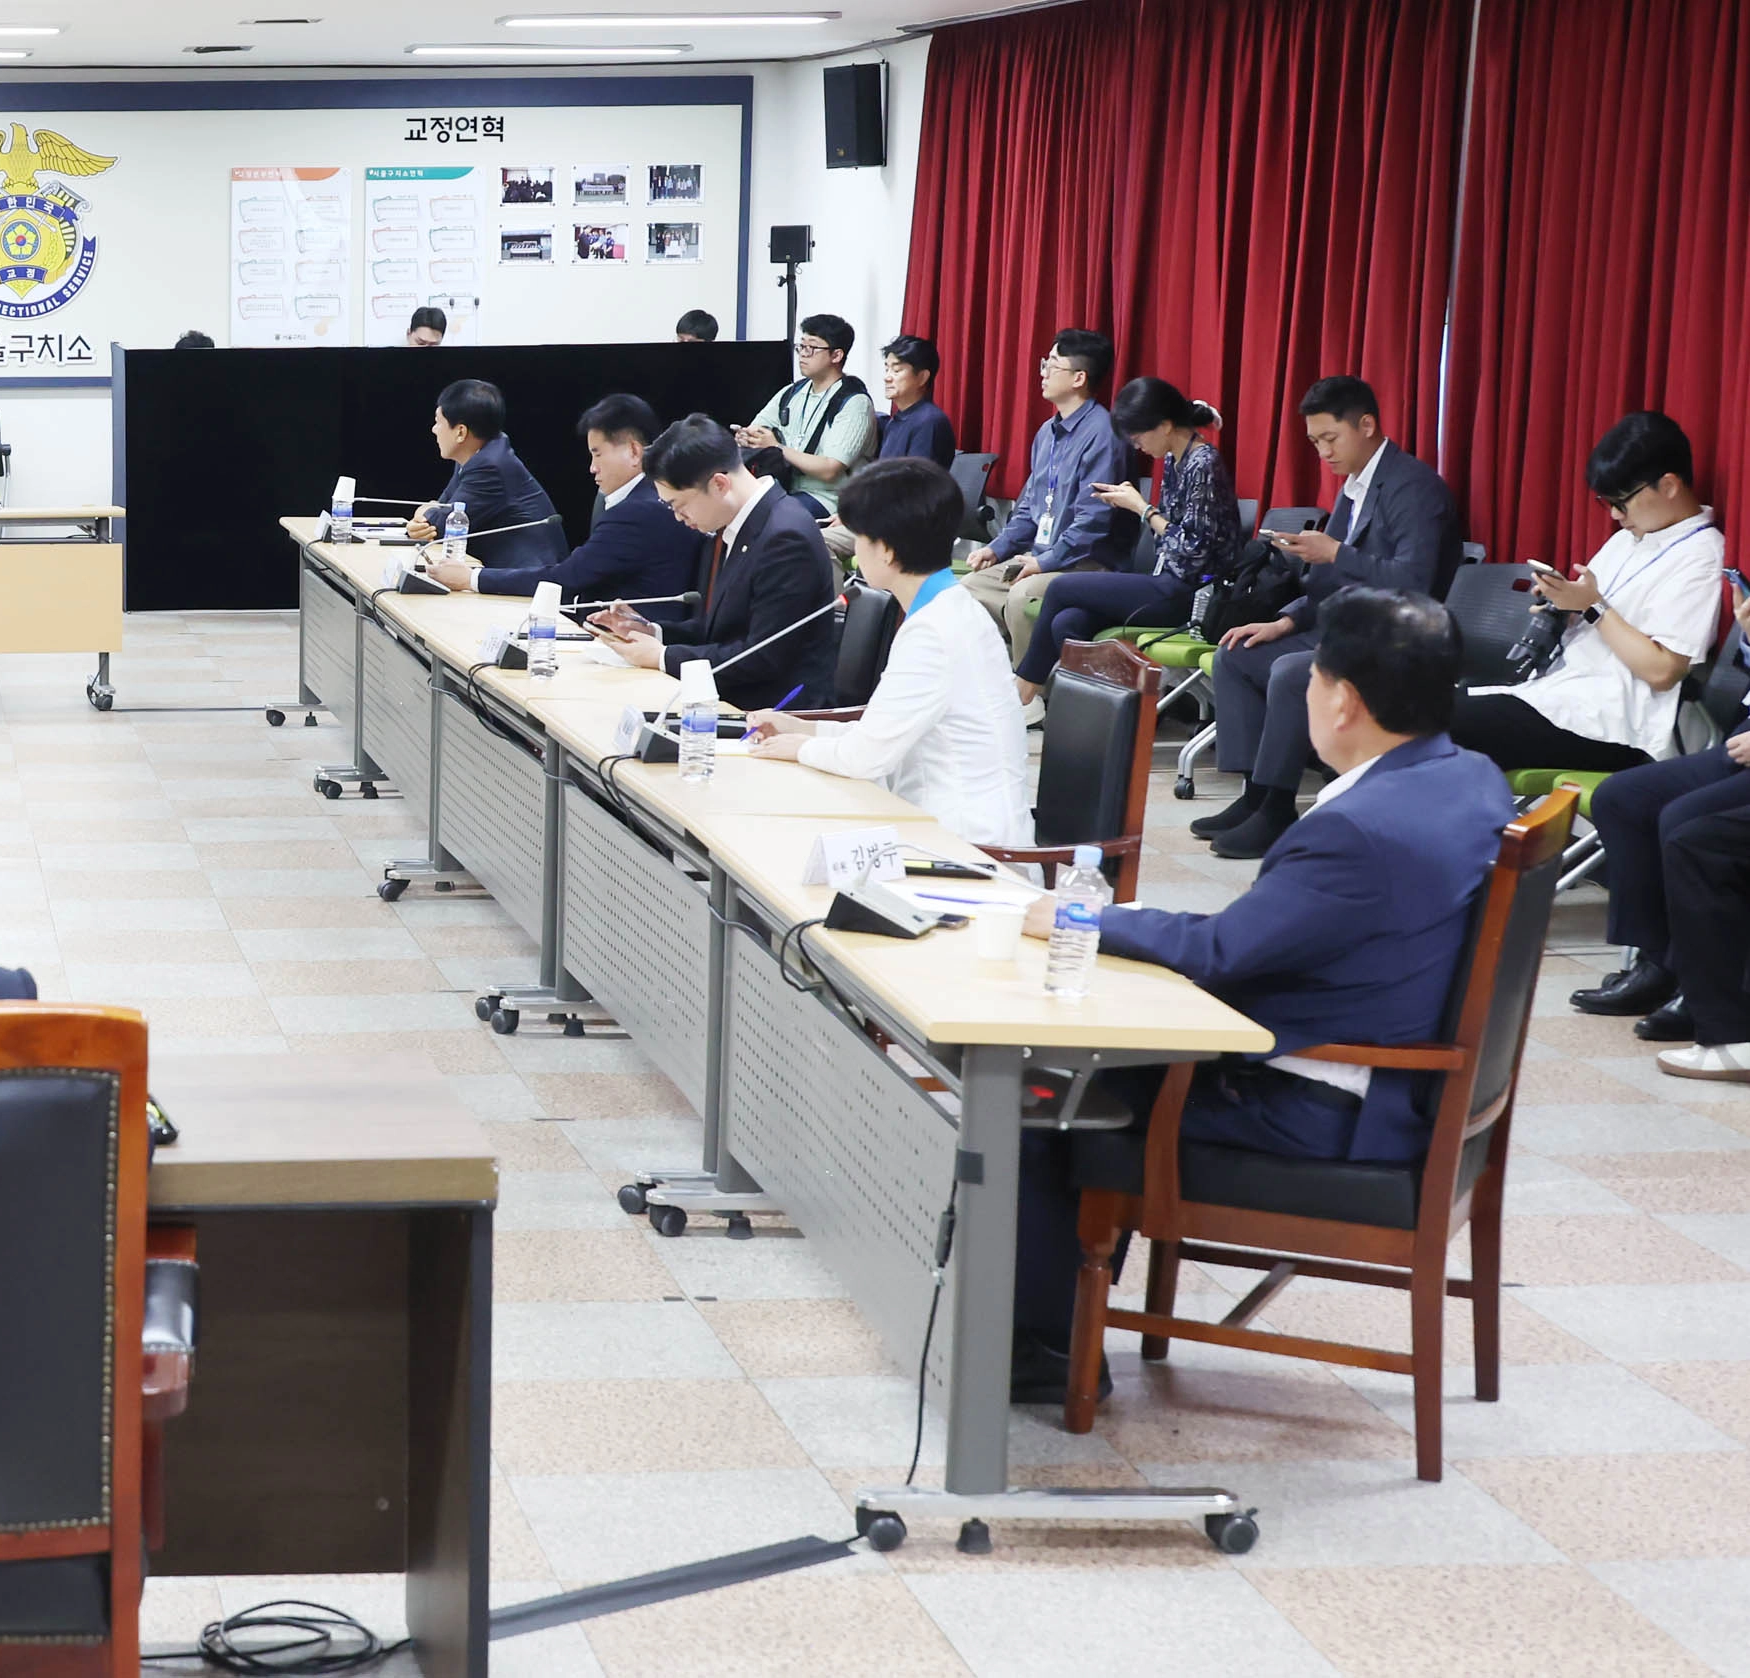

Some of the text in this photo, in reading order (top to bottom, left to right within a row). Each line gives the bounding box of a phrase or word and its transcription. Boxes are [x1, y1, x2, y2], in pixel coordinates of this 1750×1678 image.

[404, 115, 504, 143] 교정연혁
[7, 268, 36, 279] 교정
[63, 250, 94, 298] SERVICE
